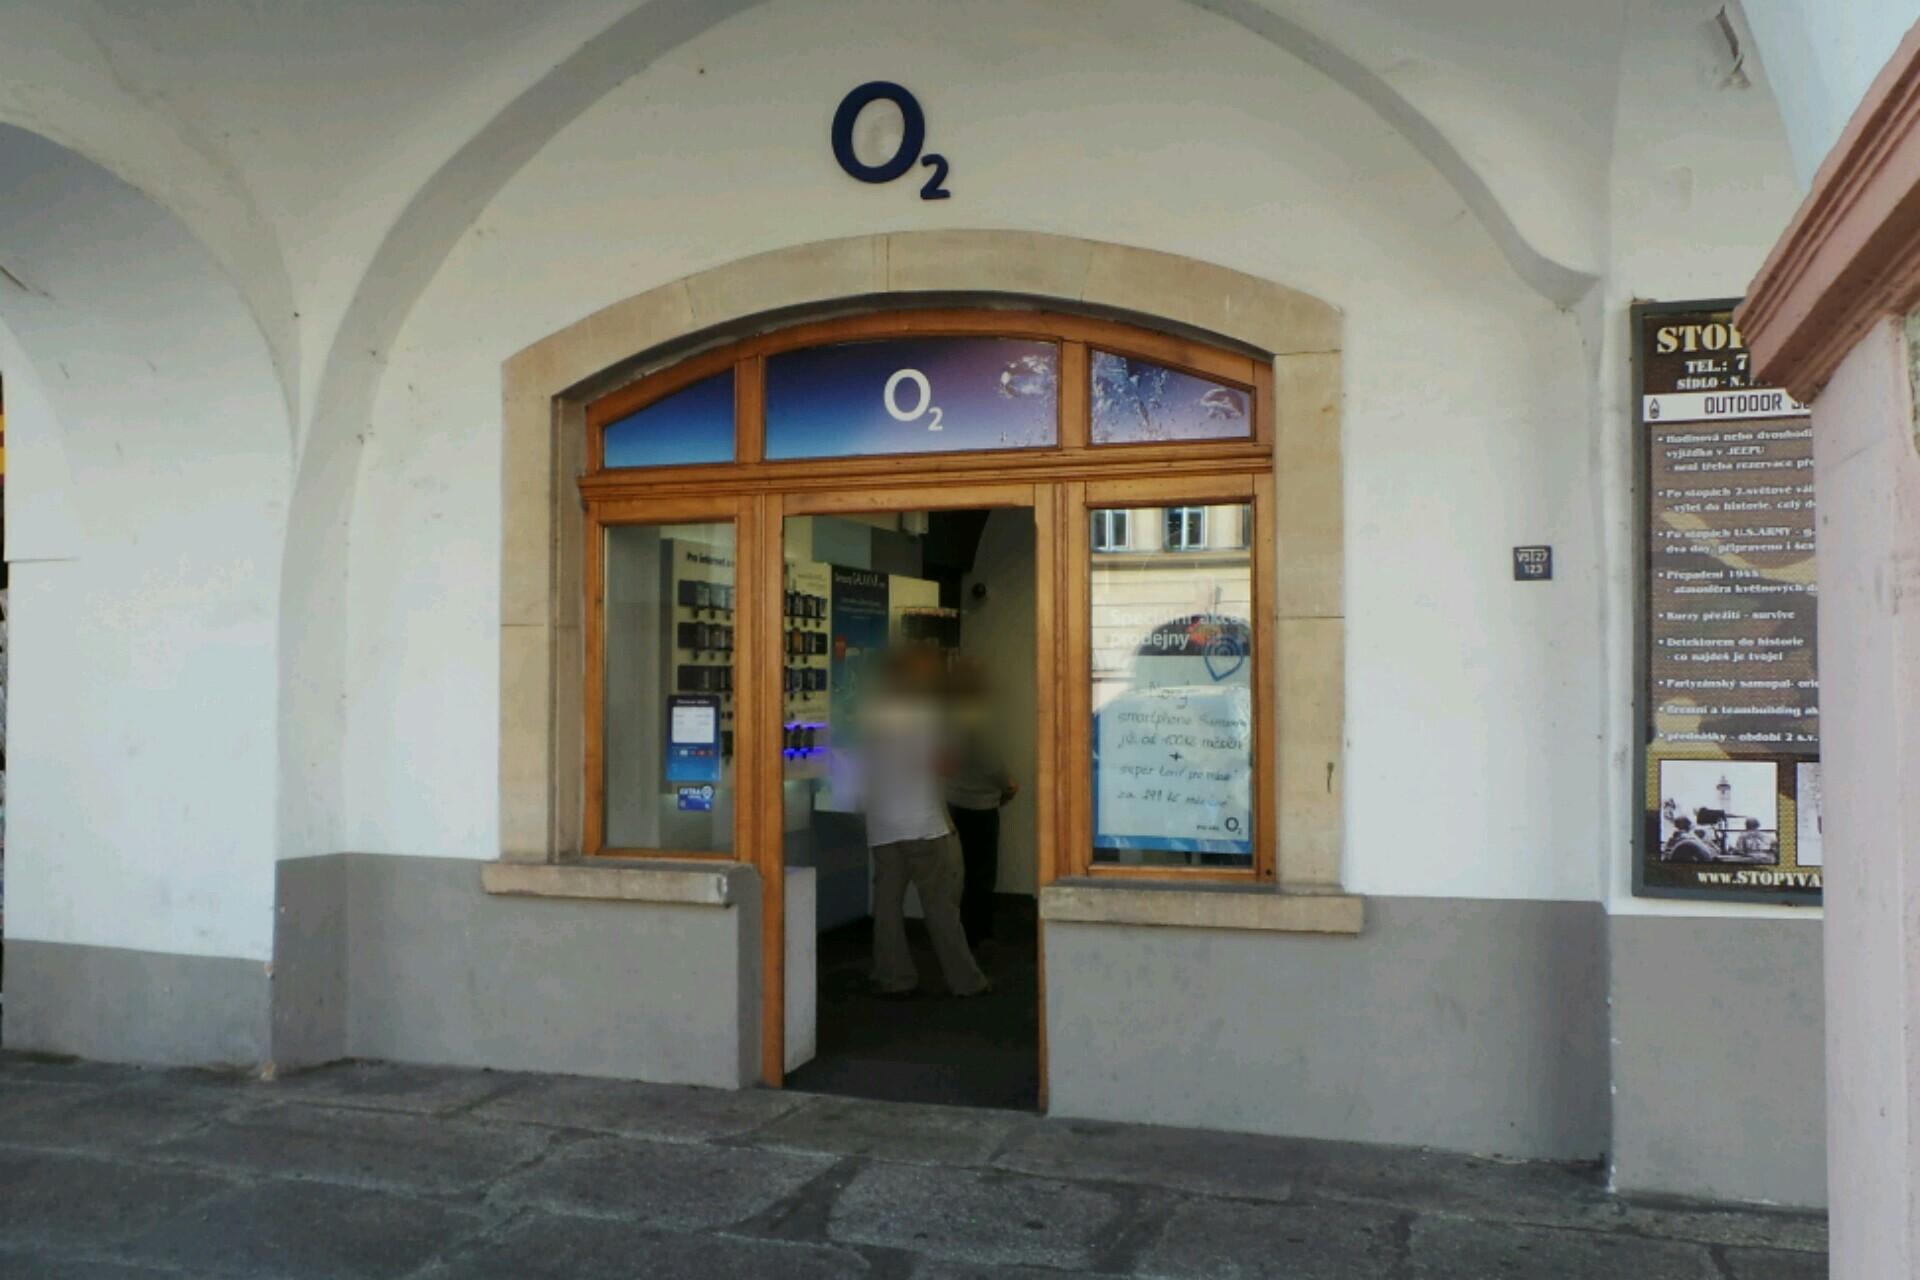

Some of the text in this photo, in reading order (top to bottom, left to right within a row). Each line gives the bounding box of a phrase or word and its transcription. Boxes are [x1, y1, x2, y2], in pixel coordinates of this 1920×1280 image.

[832, 81, 951, 200] O2
[1685, 359, 1727, 374] TEL.:
[883, 368, 944, 432] O2
[1704, 392, 1783, 414] OUTDOOR
